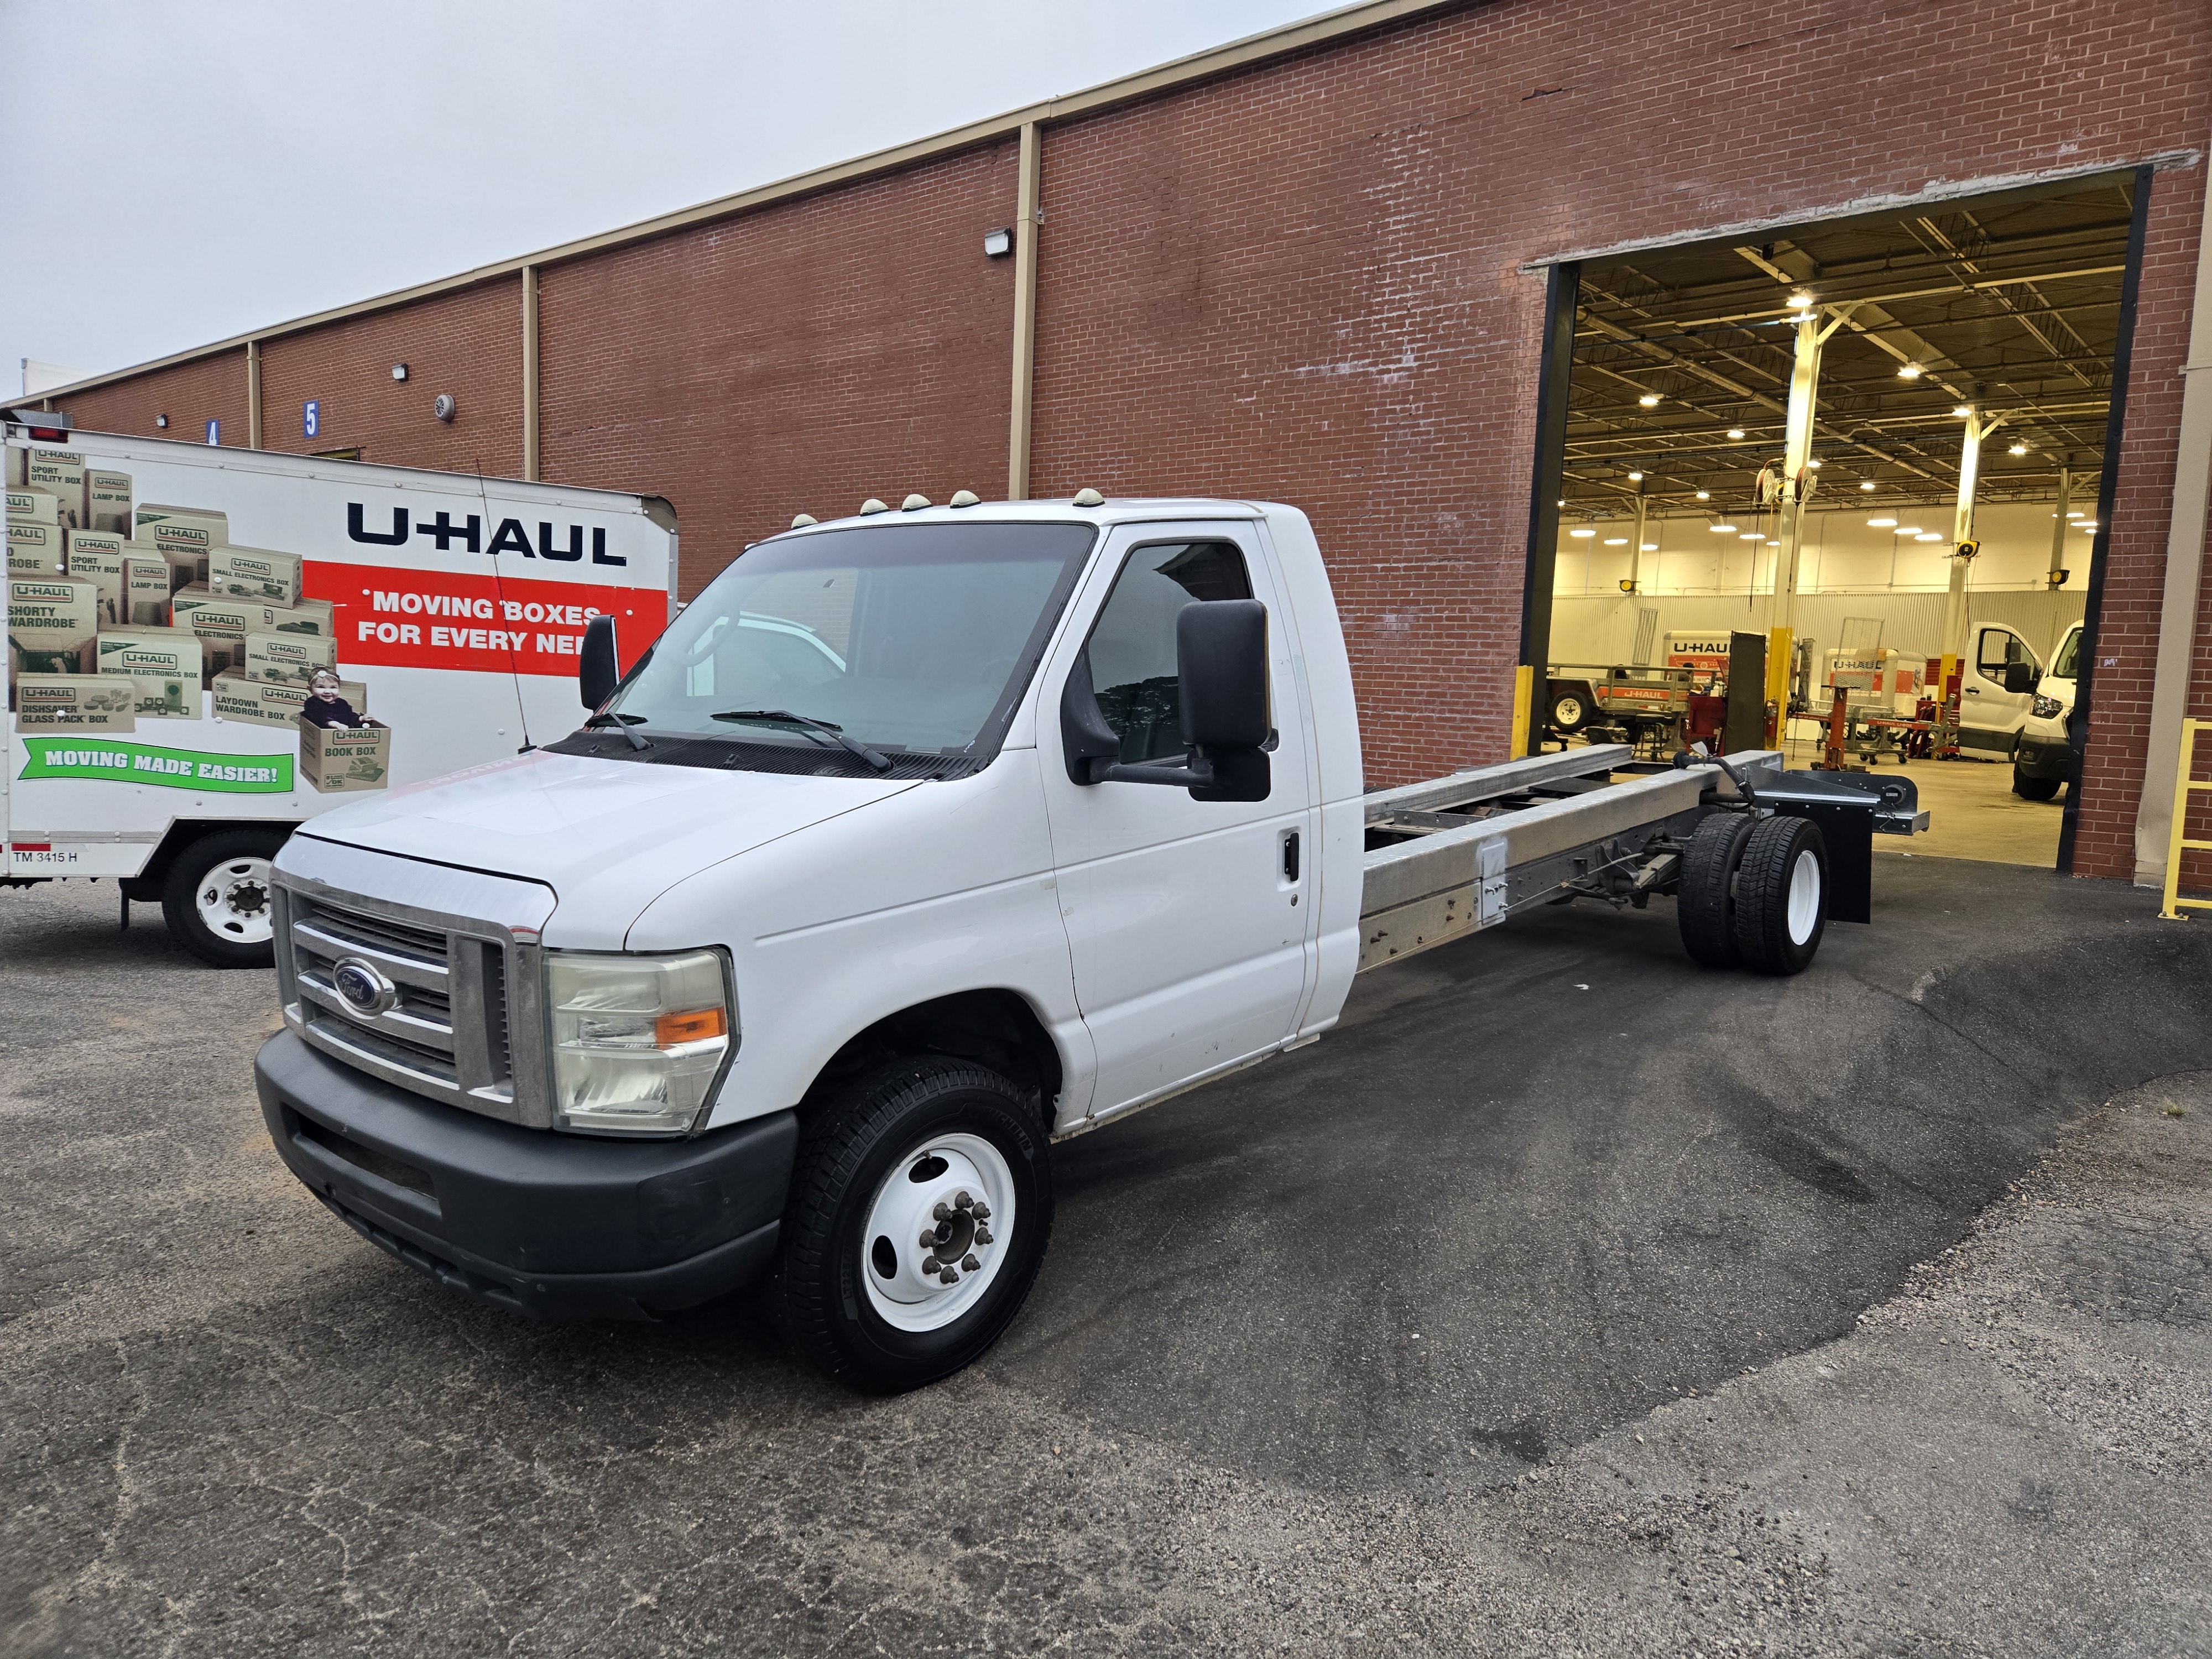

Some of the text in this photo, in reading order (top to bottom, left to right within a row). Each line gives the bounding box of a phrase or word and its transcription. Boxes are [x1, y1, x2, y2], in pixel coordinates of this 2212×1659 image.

[306, 403, 316, 435] 5
[208, 422, 217, 446] 4
[31, 466, 58, 474] SPORT
[31, 474, 62, 483] UTILITY
[158, 528, 205, 540] U-HAUL
[347, 502, 627, 566] U-HAUL
[77, 540, 117, 550] U-HAUL
[157, 544, 207, 555] ELECTRONICS
[71, 556, 97, 565] SPORT
[234, 560, 269, 571] U-HAUL
[71, 564, 101, 572] UTILITY
[212, 568, 232, 577] SMALL
[234, 572, 274, 583] ELECTRONICS
[16, 587, 70, 596] U-HAUL
[8, 606, 55, 617] SHORTY
[373, 591, 600, 625] MOVING BOXES
[195, 614, 242, 625] U-HAUL
[195, 630, 243, 640] ELECTRONICS
[358, 621, 421, 645] FOR
[431, 626, 528, 651] EVERY
[270, 644, 304, 655] U-HAUL
[1674, 643, 1732, 653] U-HAU
[126, 654, 174, 664] U-HAUL
[270, 656, 310, 667] ELECTRONICS
[265, 690, 306, 701] U-HAUL
[216, 696, 258, 708] LAYDOWN
[22, 705, 77, 713] DISHSAVER
[216, 704, 285, 720] WARDROBE BOX
[22, 715, 108, 723] GLASS PACK BOX
[325, 748, 353, 757] BOOK
[356, 747, 377, 755] BOX
[45, 750, 128, 769] MOVING
[134, 755, 193, 776] MADE
[197, 763, 278, 783] EASIER!
[13, 852, 77, 862] TM 3415 H
[340, 973, 364, 1000] Ford
